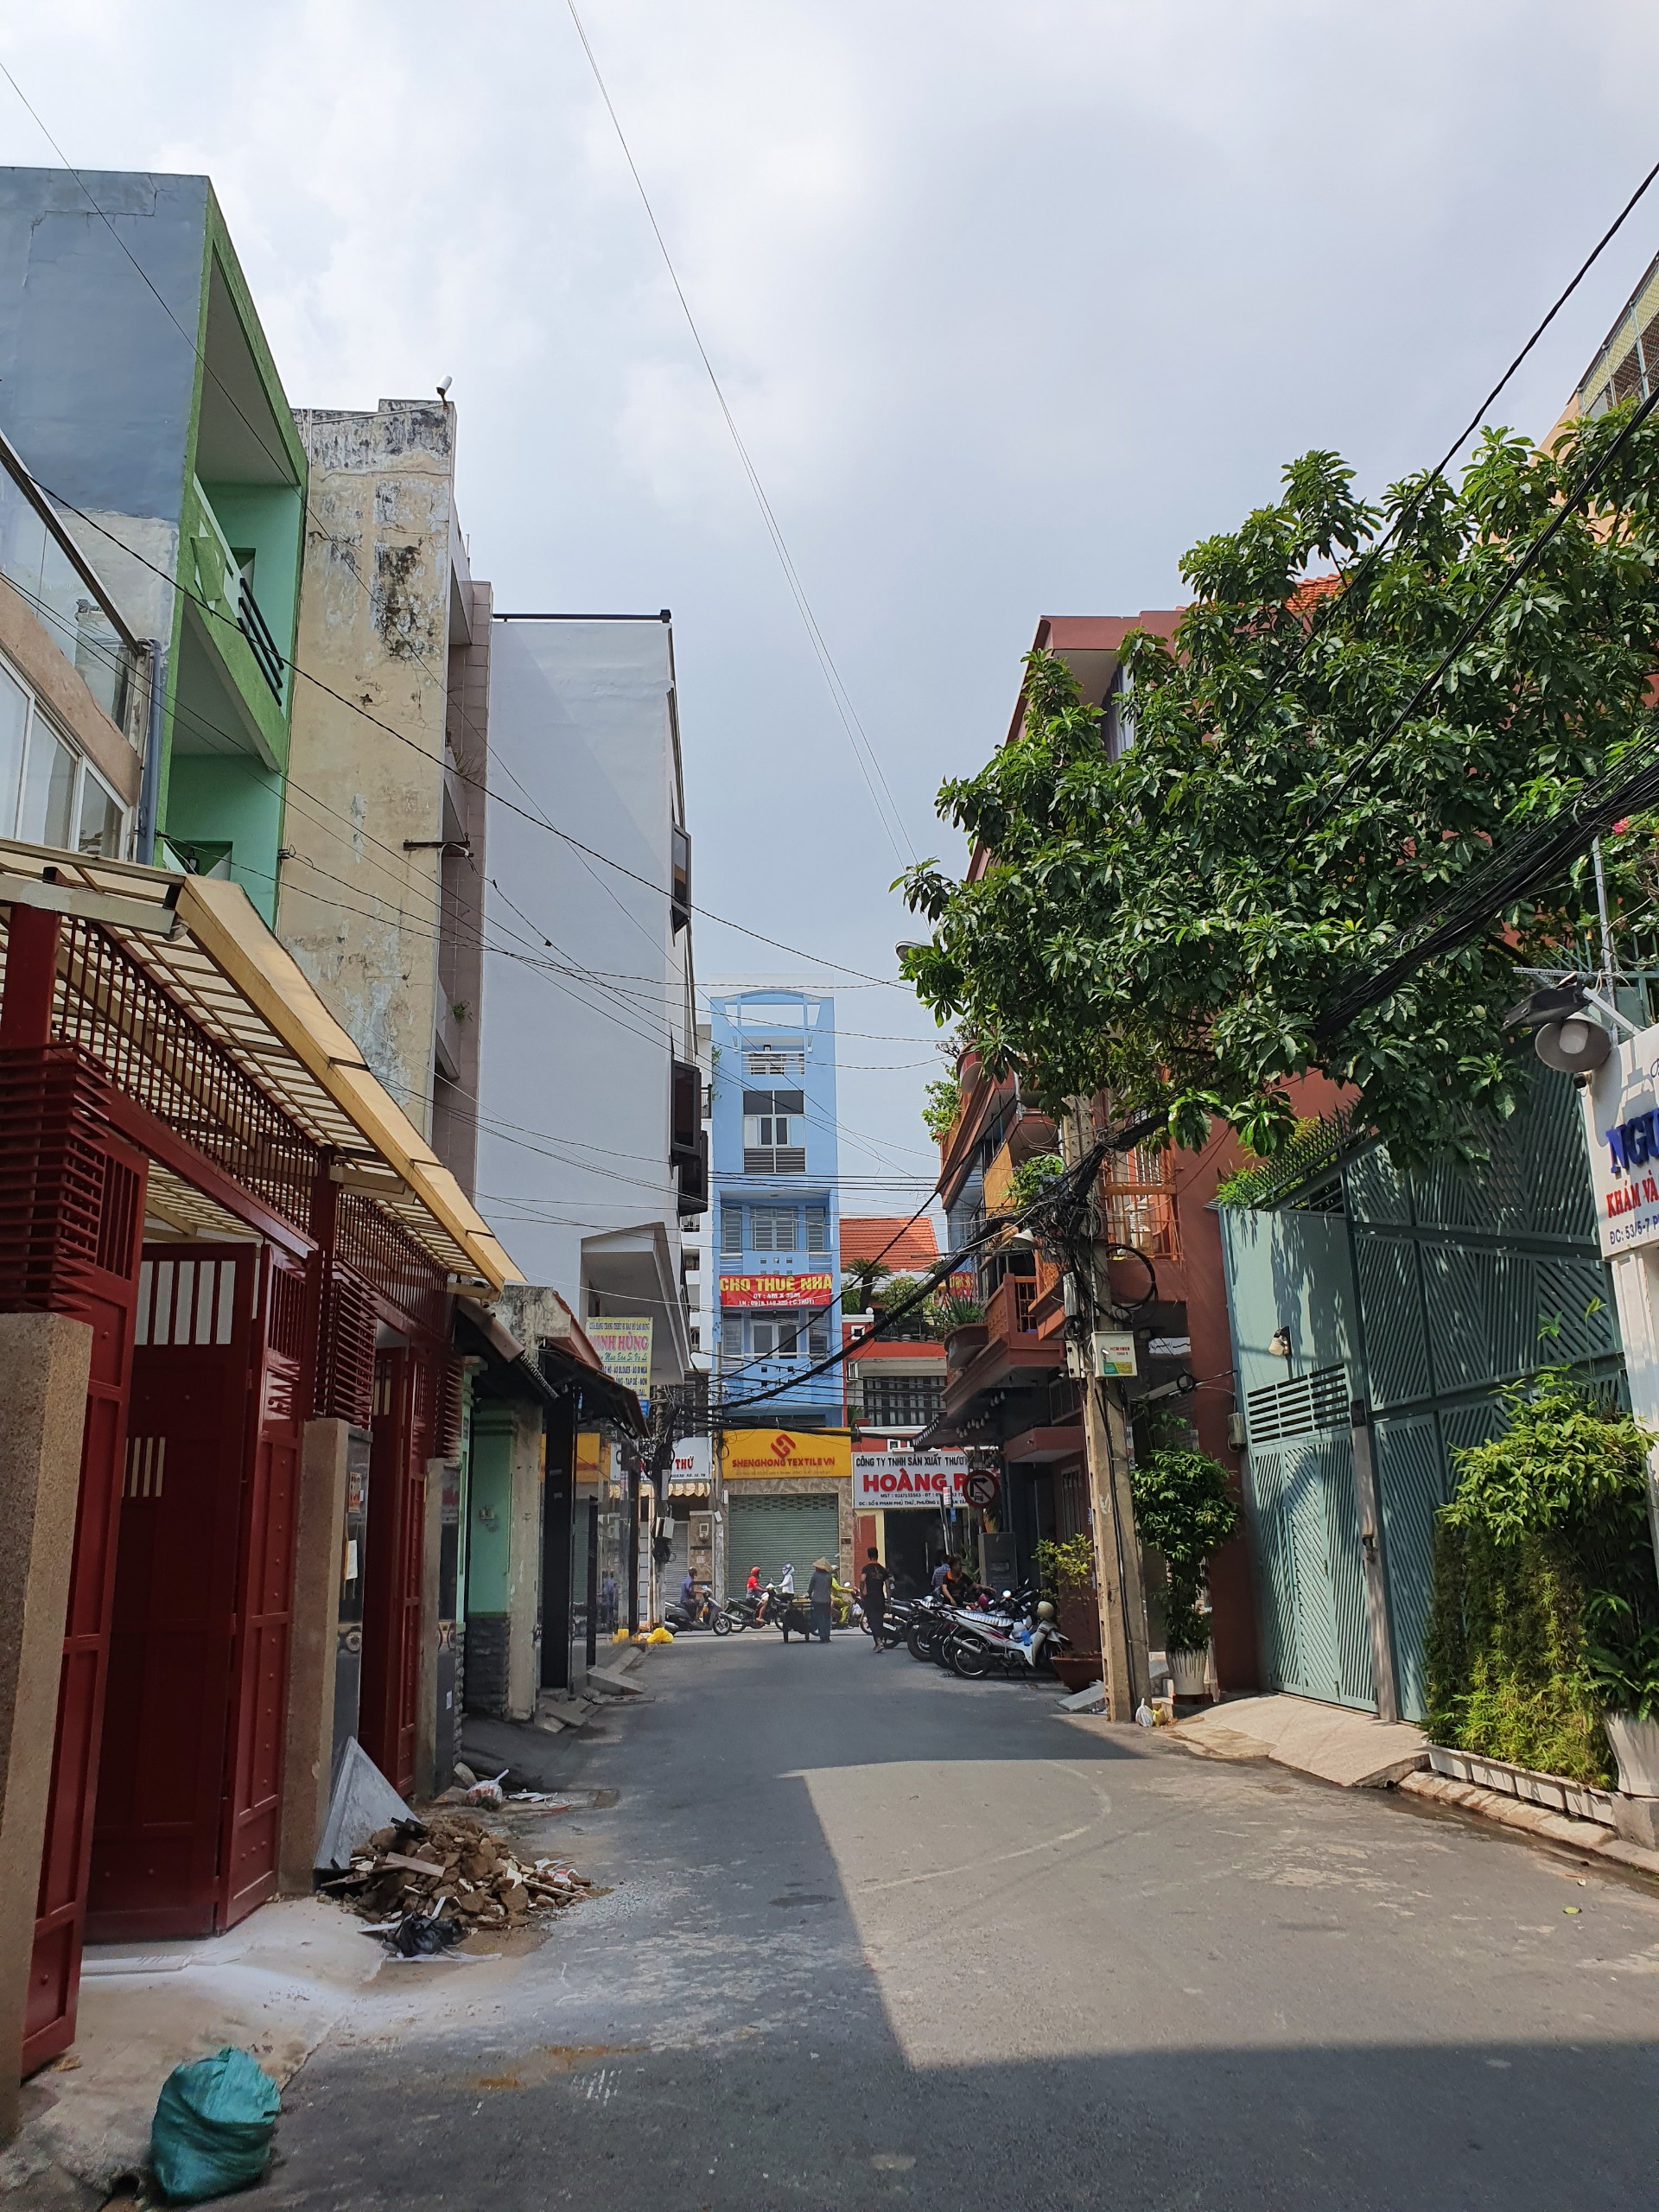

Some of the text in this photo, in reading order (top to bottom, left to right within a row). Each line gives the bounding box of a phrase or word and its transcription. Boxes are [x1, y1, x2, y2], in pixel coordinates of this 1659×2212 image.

[1606, 1179, 1642, 1218] KHÁM
[720, 1274, 832, 1292] CHO THUÊ NHÀ
[675, 1455, 694, 1470] THỨ
[732, 1457, 835, 1468] SHENGHONG TEXTILE VN
[856, 1455, 875, 1467] CÔNG
[876, 1457, 886, 1467] TY
[888, 1457, 906, 1466] TNHH
[908, 1454, 922, 1466] SẢN
[925, 1453, 942, 1466] XUẤT
[863, 1468, 947, 1492] HOÀNG
